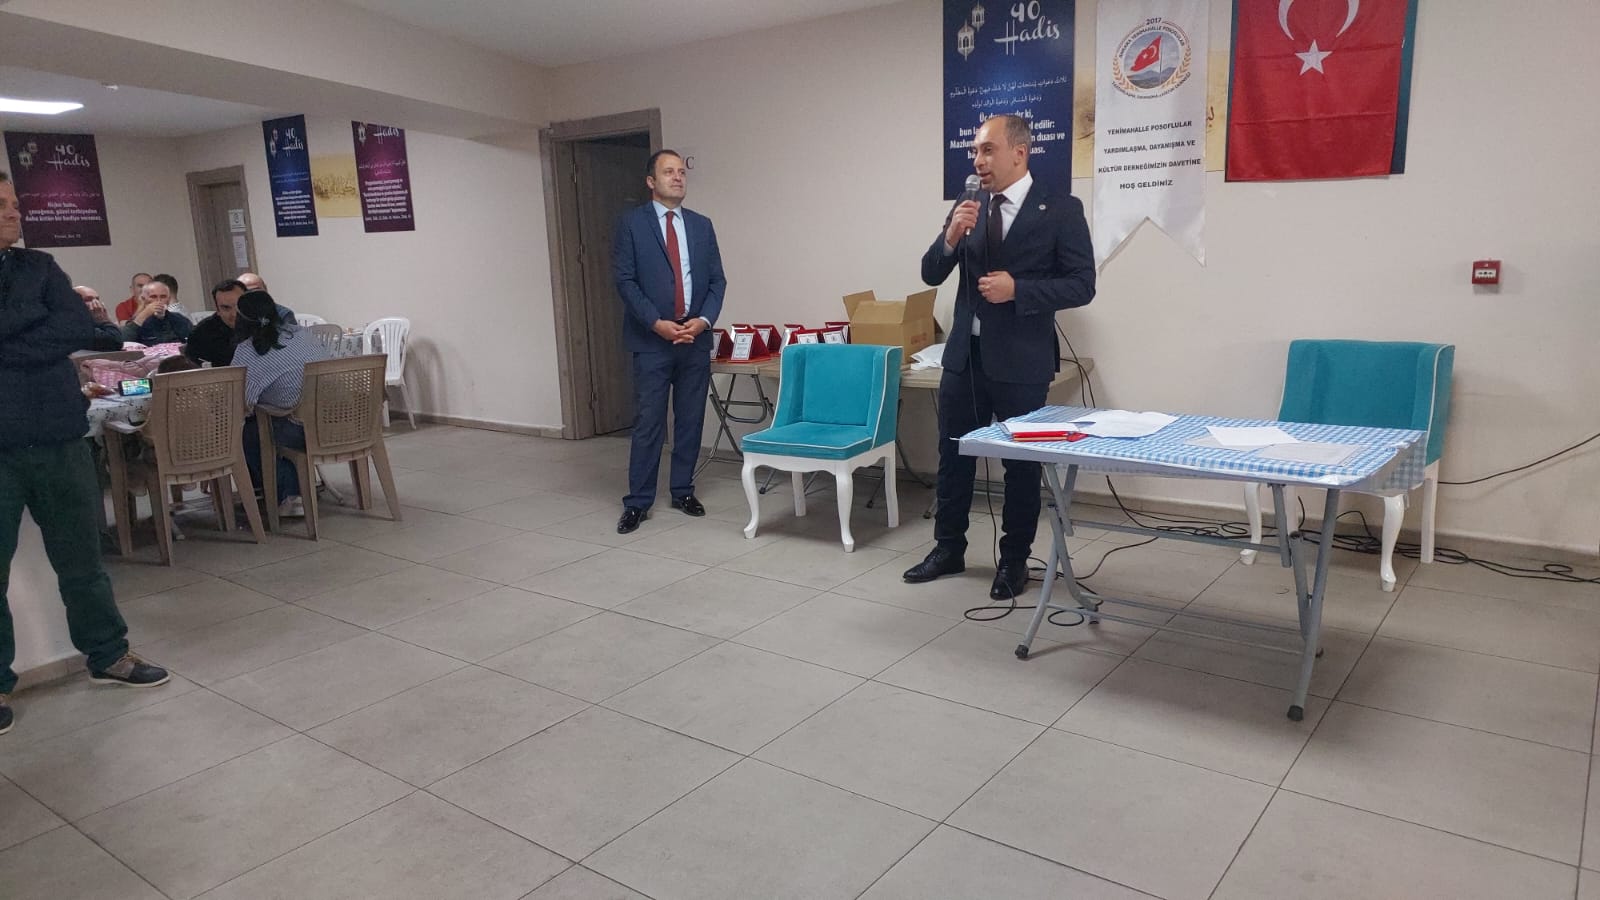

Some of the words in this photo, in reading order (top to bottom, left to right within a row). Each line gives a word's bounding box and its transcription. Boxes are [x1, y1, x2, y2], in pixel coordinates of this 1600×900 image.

[1011, 0, 1041, 22] 40
[1146, 17, 1162, 25] 2017
[994, 16, 1060, 56] Hadis
[1034, 120, 1055, 129] edilir:
[1107, 125, 1149, 135] YENİMAHALLE
[1151, 120, 1192, 131] POSOFLULAR
[285, 127, 296, 139] 40
[1037, 132, 1056, 142] duası
[1057, 131, 1066, 140] ve
[55, 144, 76, 156] 40
[1104, 145, 1148, 155] YARDIMLAŞMA,
[1149, 141, 1185, 151] DAYANIŞMA
[47, 152, 90, 171] Hadis
[1098, 164, 1122, 173] KÜLTÜR
[1123, 162, 1167, 171] DERNEĞİMİZİN
[1168, 158, 1201, 167] DAVETİNE
[1120, 182, 1135, 190] HOŞ
[1137, 179, 1173, 188] GELDİNİZ
